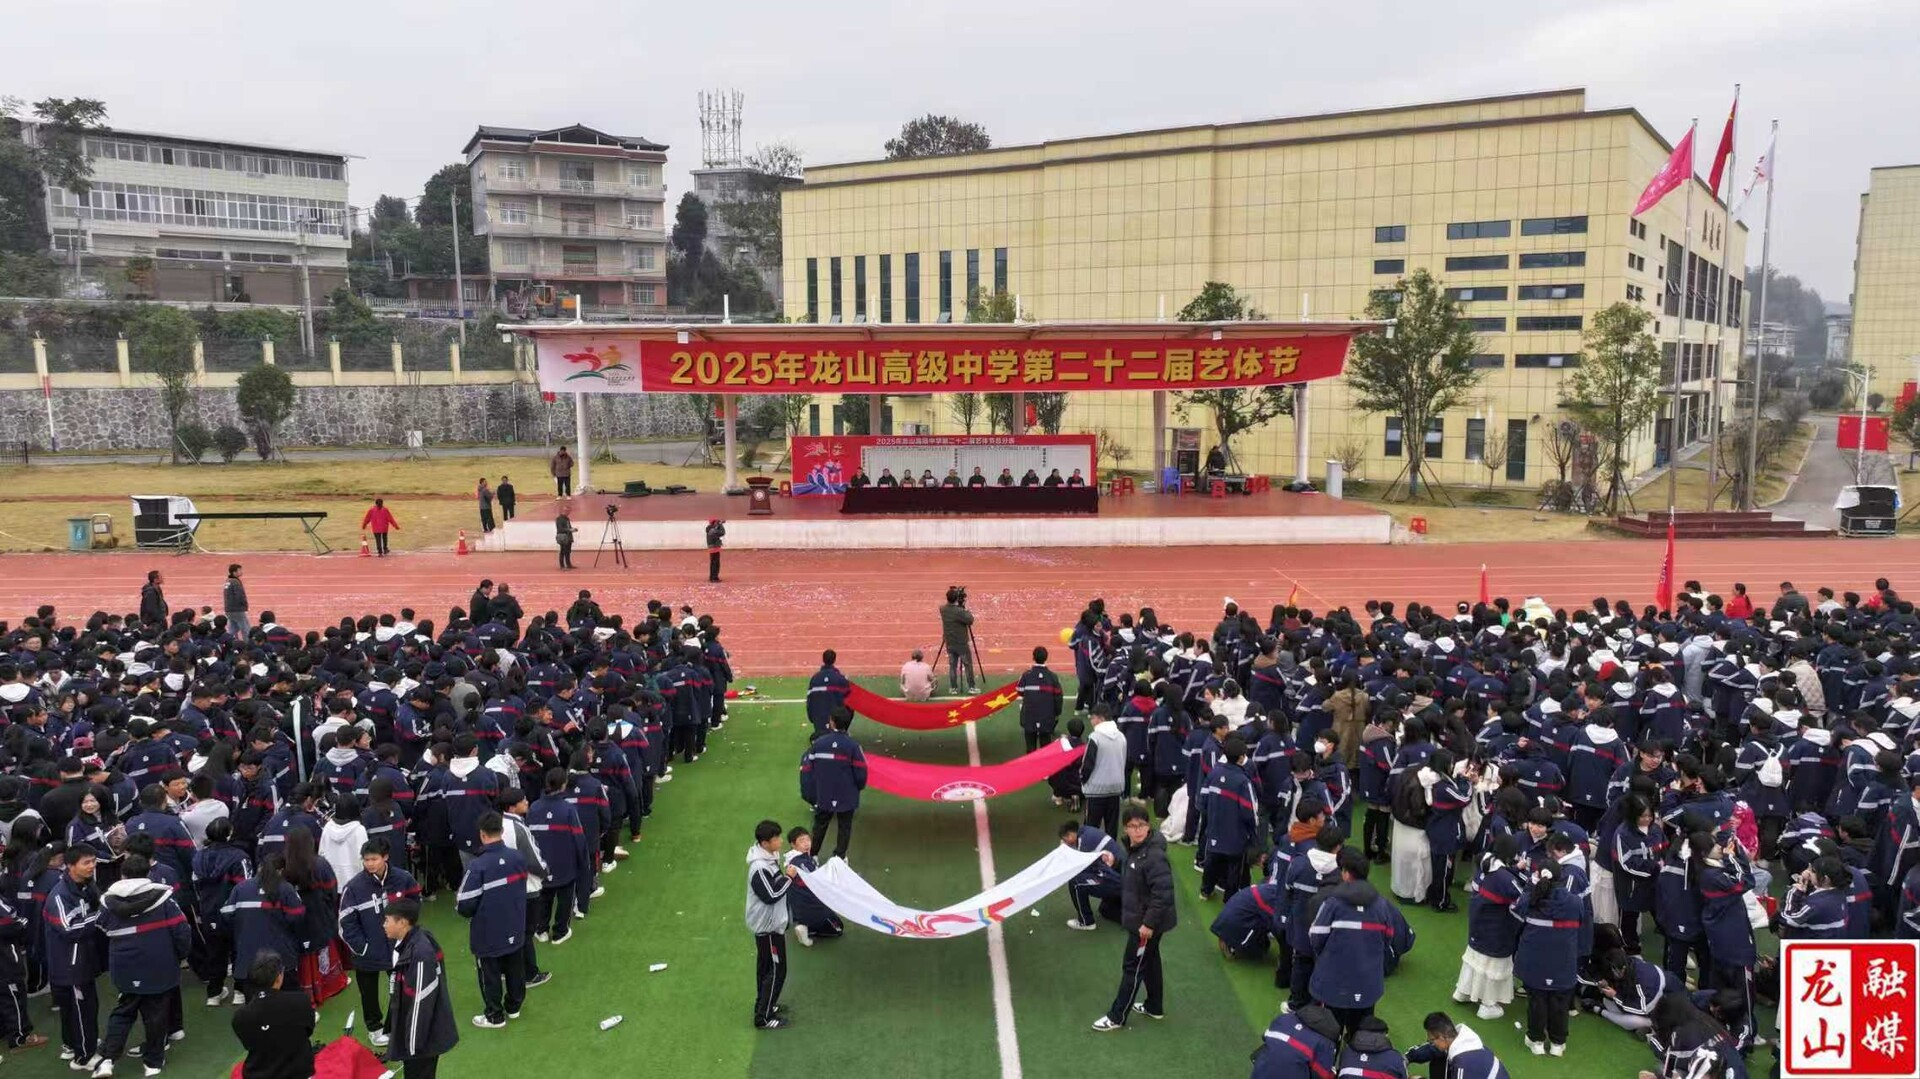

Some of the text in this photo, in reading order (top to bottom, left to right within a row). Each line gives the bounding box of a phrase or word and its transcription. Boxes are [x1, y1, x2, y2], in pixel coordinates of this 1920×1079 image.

[669, 346, 1302, 385] 2025年龙山高级中学第二十二届艺体节
